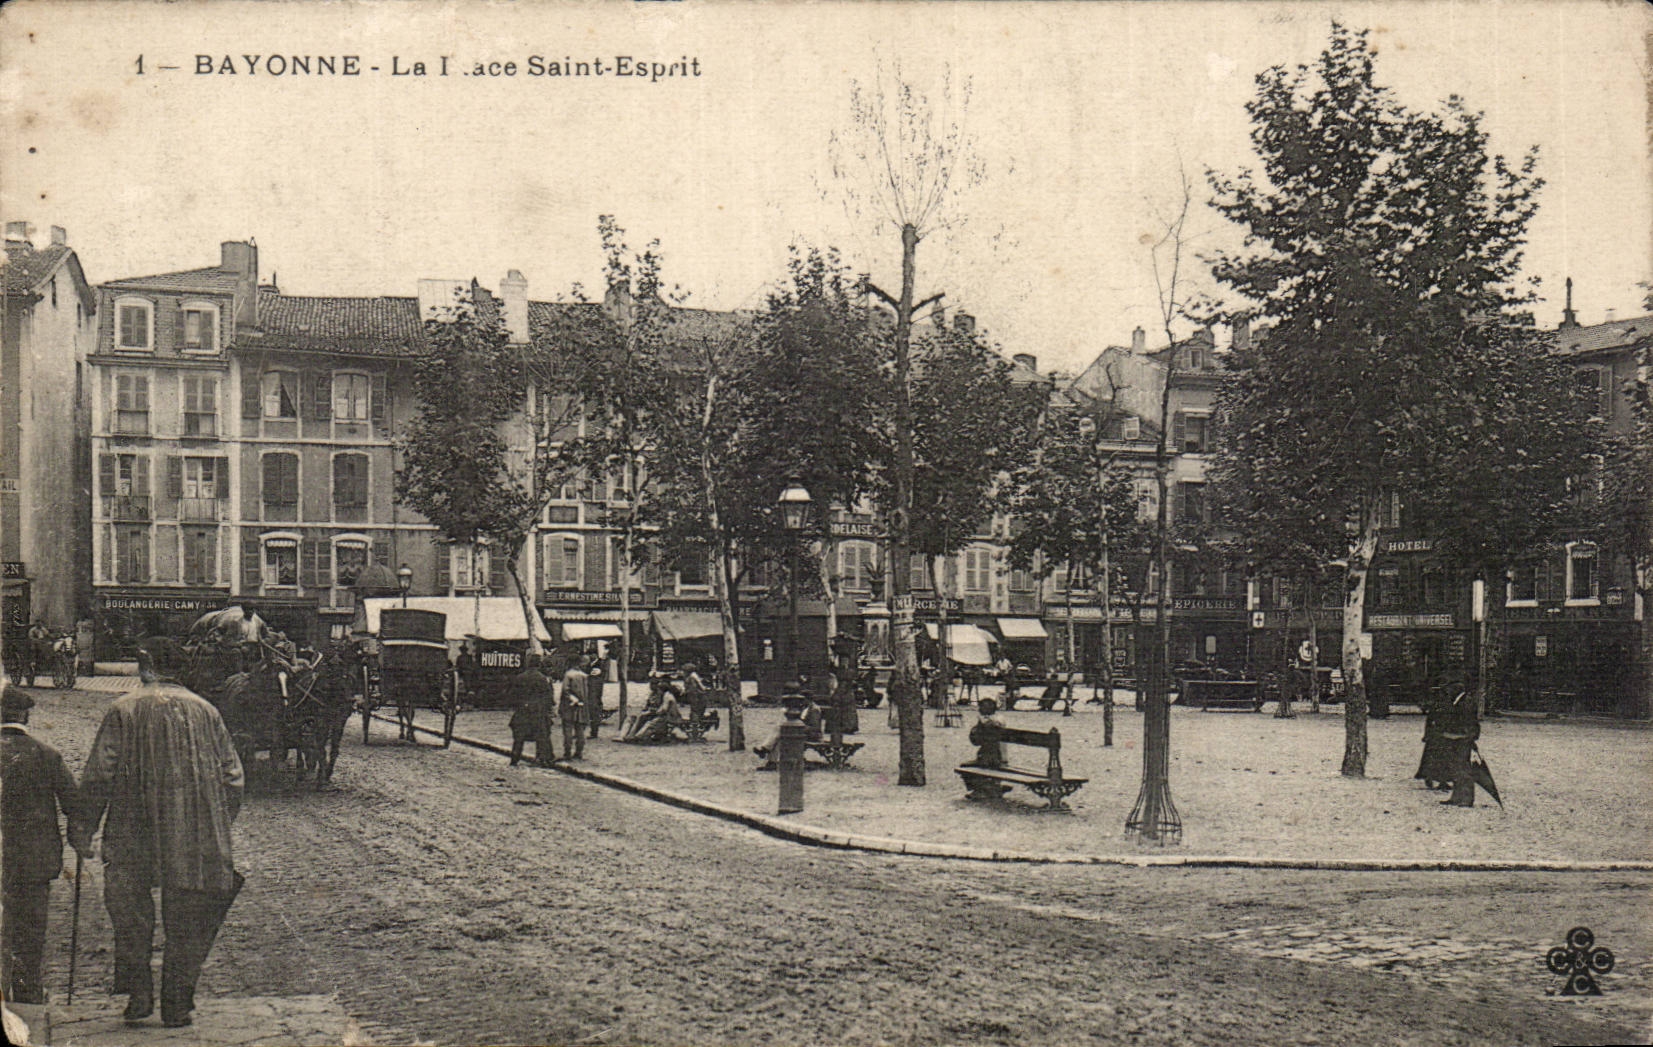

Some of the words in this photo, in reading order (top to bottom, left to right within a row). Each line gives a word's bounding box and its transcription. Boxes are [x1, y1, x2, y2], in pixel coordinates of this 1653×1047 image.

[1388, 541, 1431, 551] HOTEL
[105, 600, 170, 609] BOULANGERIE
[174, 600, 201, 610] CAMY
[1174, 599, 1237, 609] EPICERIE
[481, 651, 521, 668] HUÎTRES
